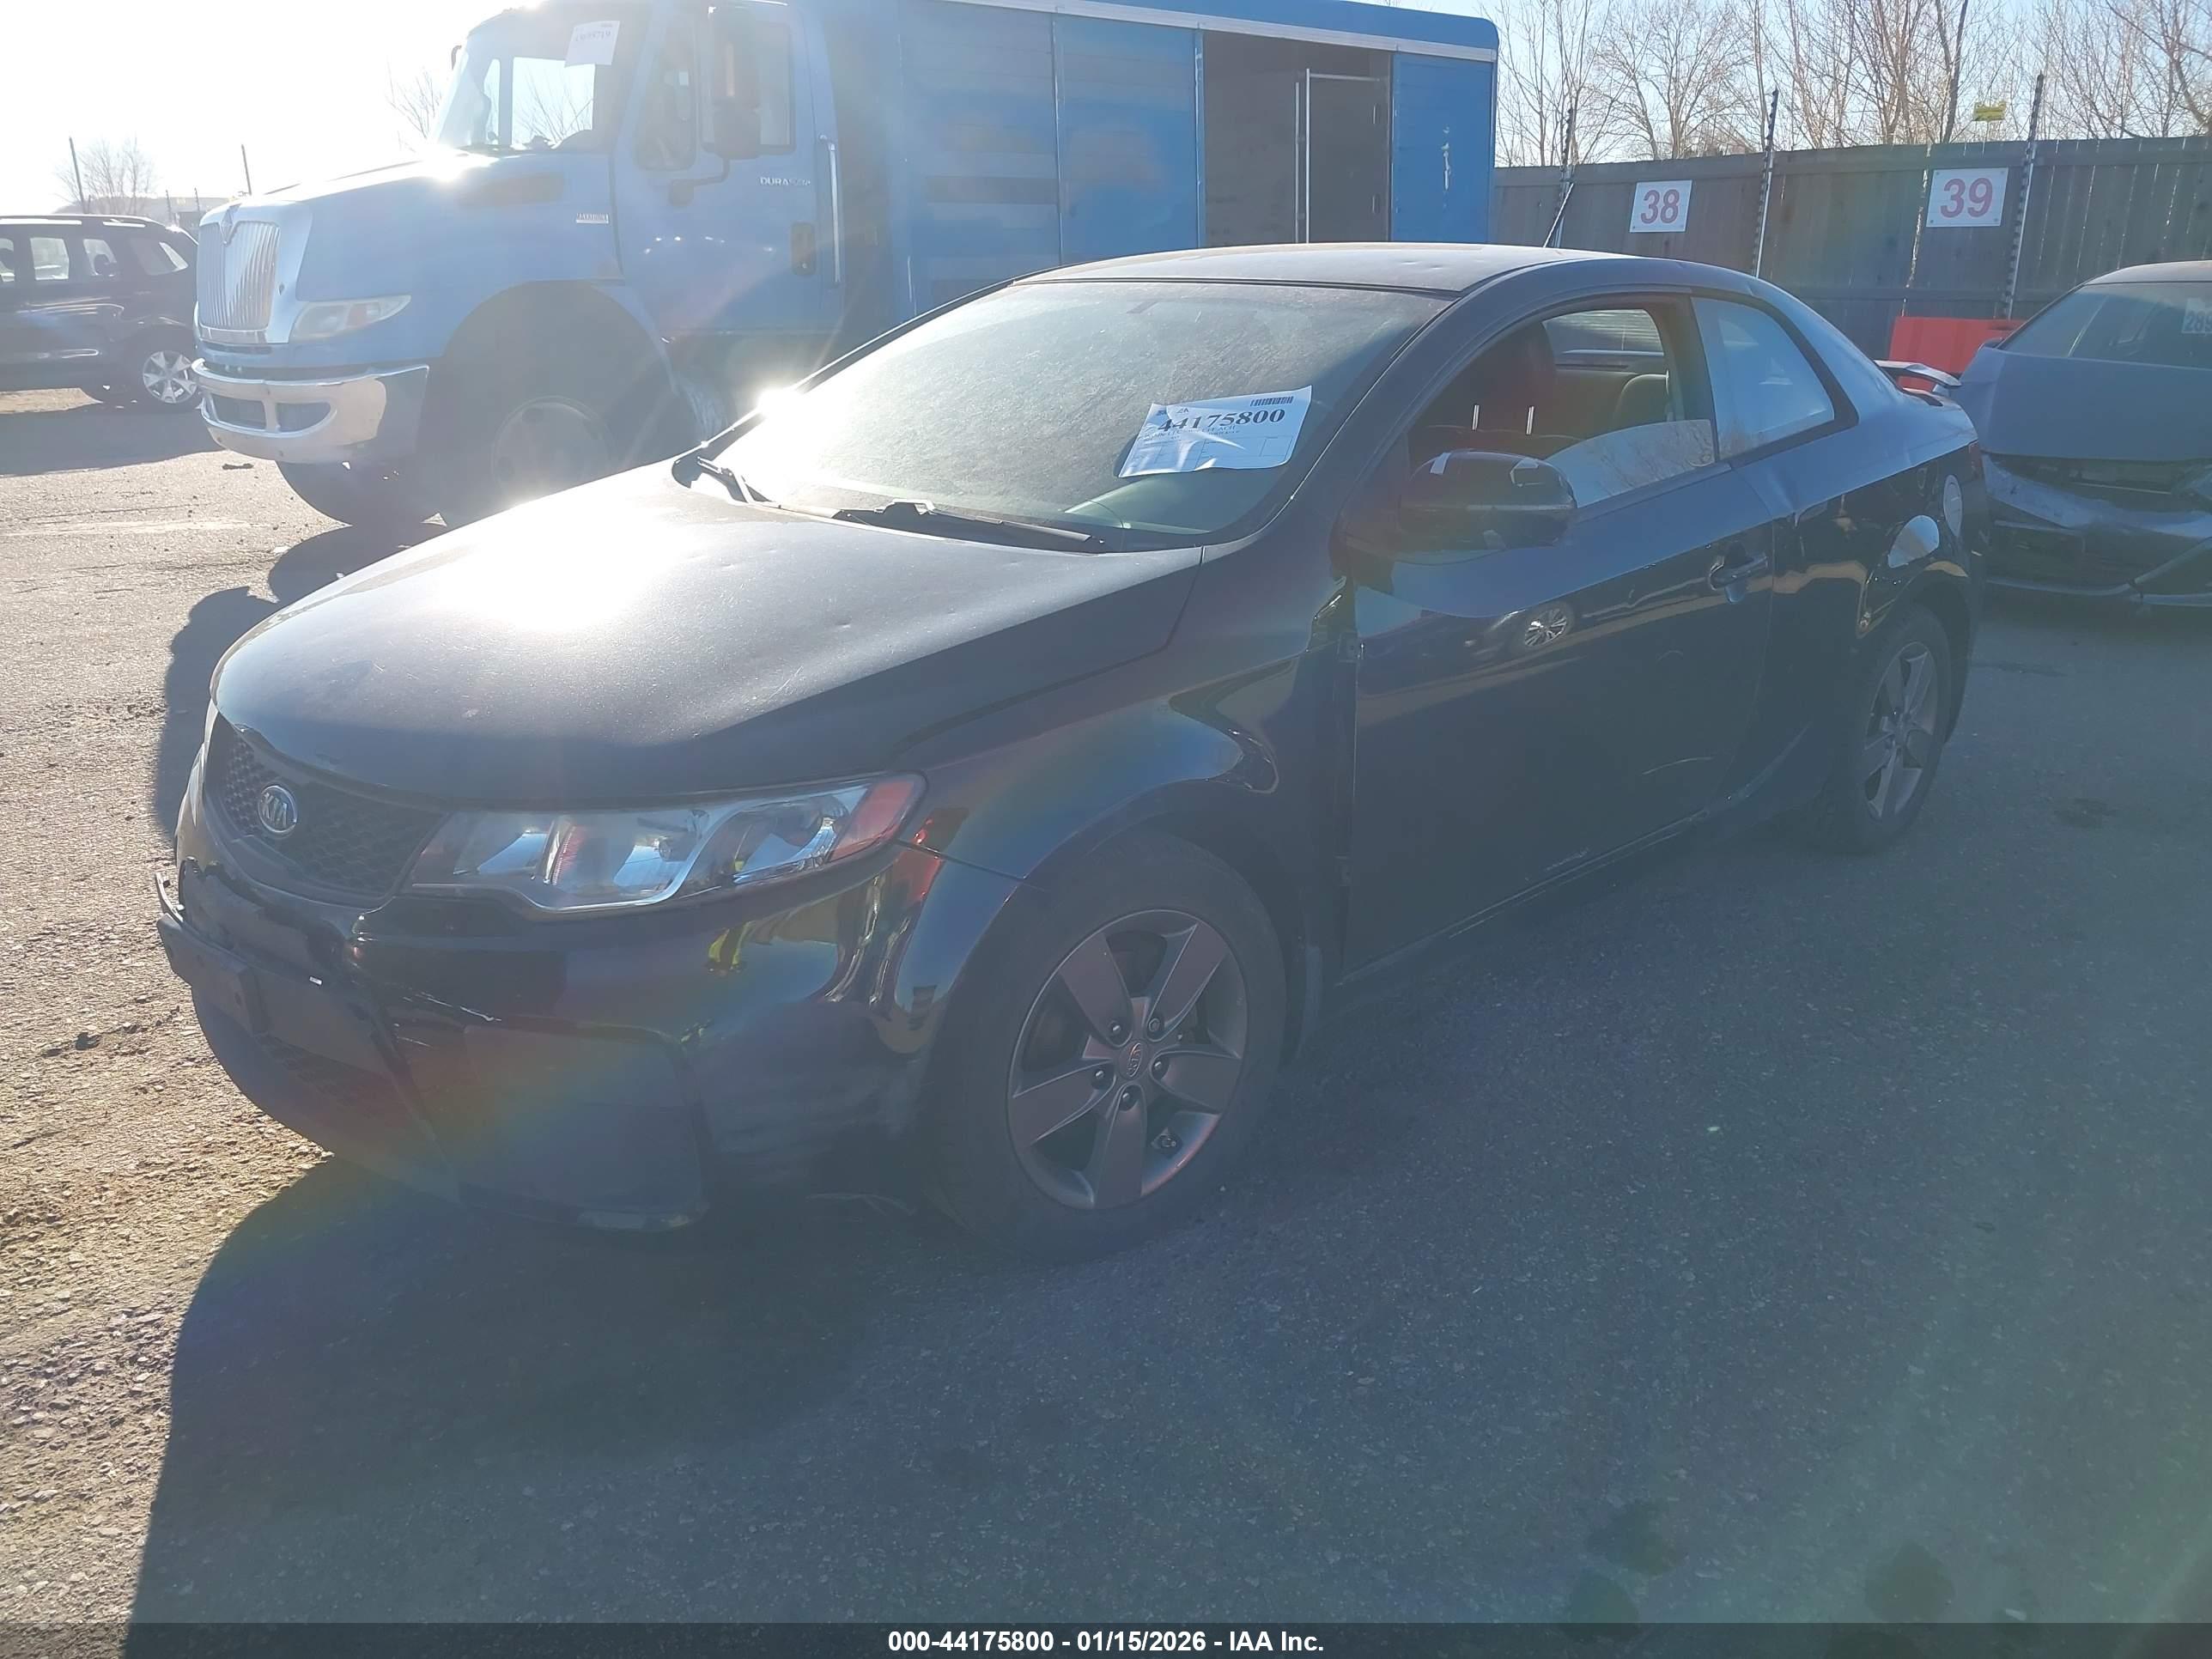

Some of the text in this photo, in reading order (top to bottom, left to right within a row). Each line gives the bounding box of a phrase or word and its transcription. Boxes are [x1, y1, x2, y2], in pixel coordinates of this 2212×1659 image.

[1641, 189, 1680, 224] 38
[1940, 178, 1993, 218] 39
[1158, 409, 1285, 432] 44175800
[262, 792, 288, 829] KIA
